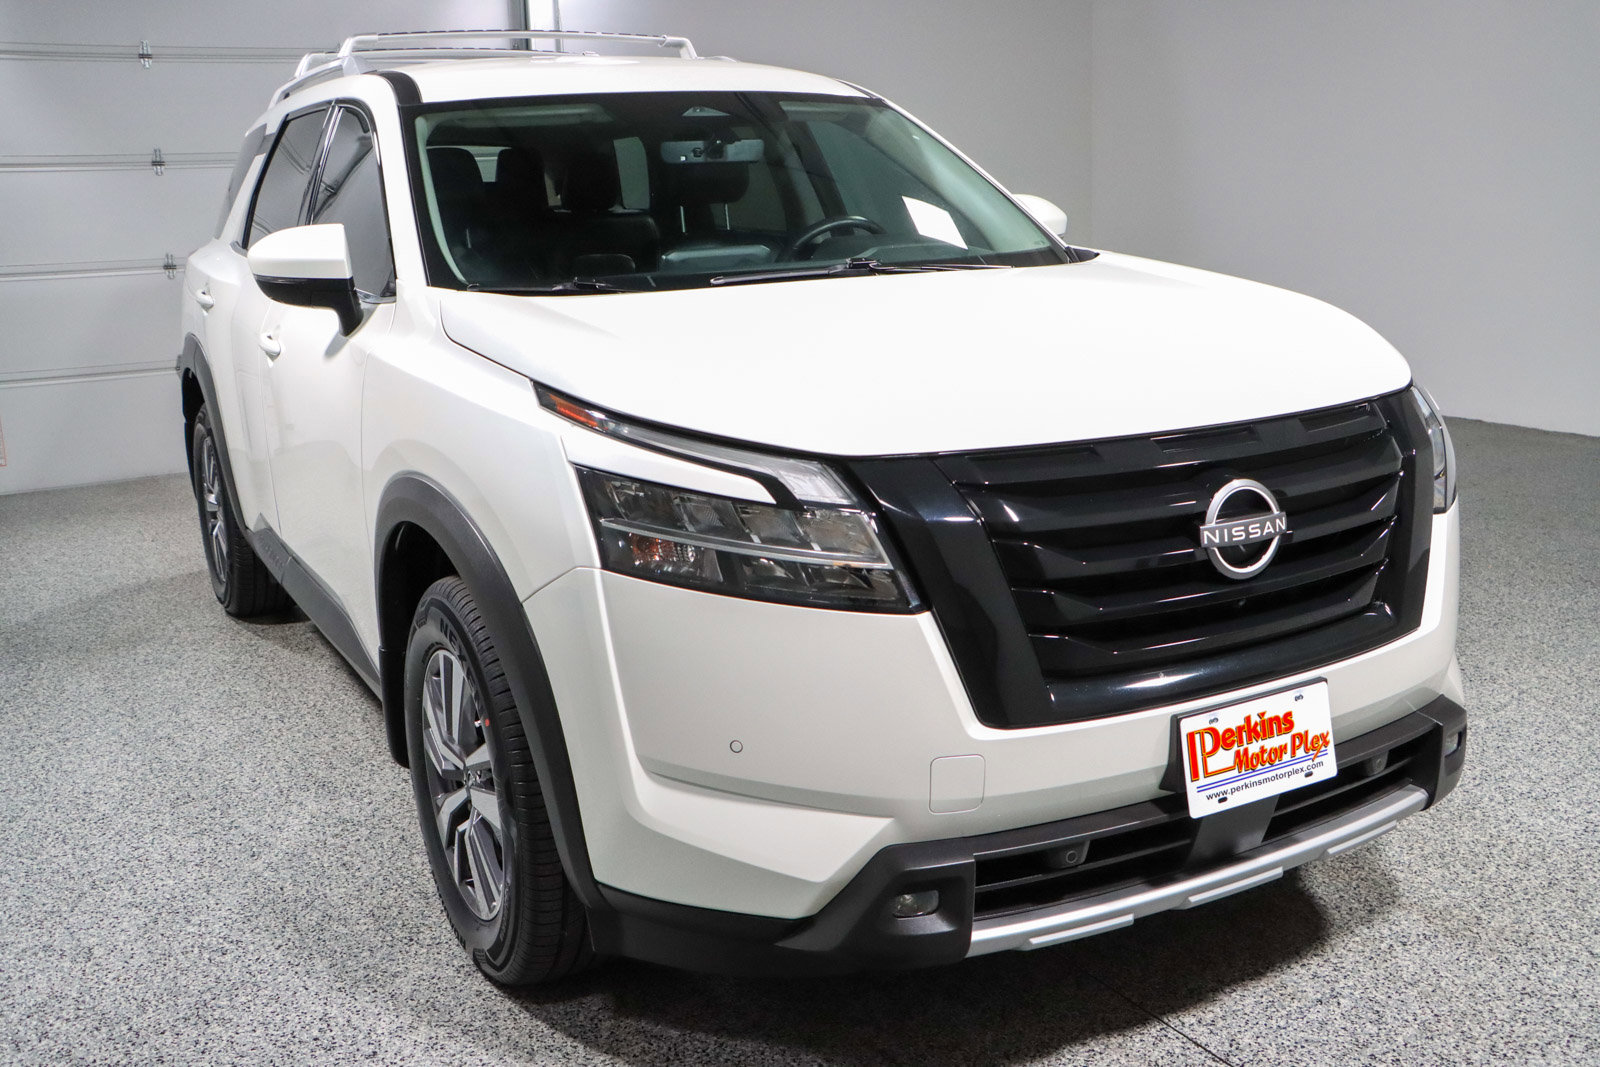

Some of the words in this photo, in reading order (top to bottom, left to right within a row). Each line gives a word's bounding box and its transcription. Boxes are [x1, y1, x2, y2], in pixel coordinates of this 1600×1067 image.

[1203, 516, 1286, 545] NISSAN
[1187, 710, 1295, 782] Perkins
[1233, 742, 1289, 773] Motor
[1291, 729, 1330, 762] Plex
[1206, 761, 1324, 801] www.perkinsmotorplex.com
